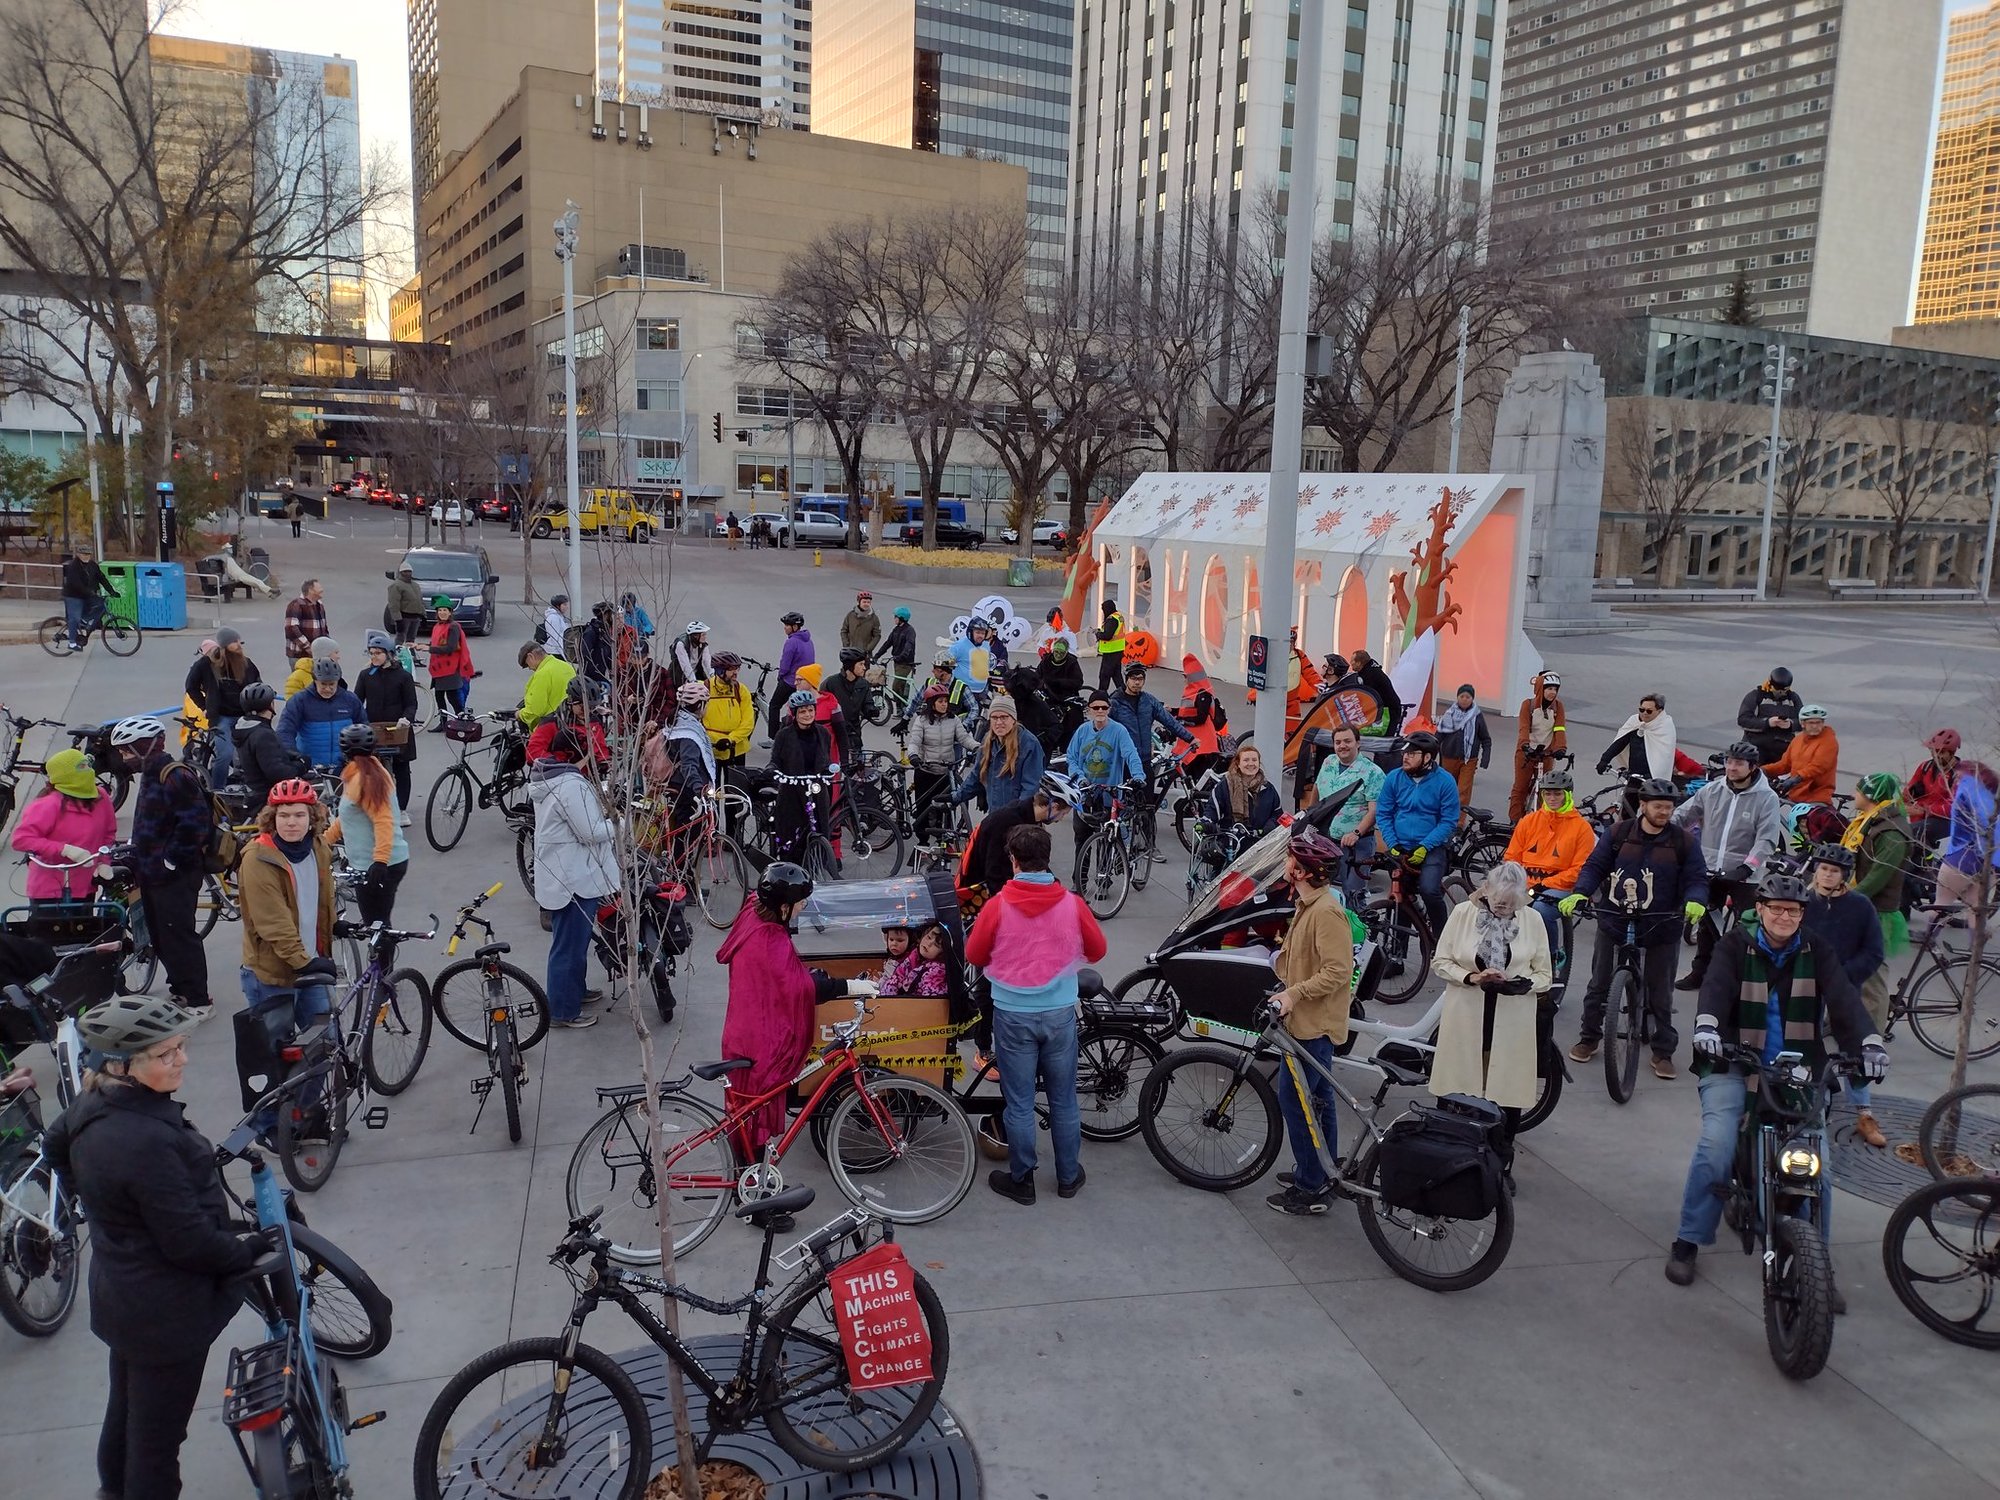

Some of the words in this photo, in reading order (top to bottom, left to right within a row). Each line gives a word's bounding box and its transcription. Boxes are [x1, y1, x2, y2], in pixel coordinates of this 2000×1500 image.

[1340, 694, 1363, 727] JANZ
[871, 1033, 908, 1045] DANGER
[921, 1027, 957, 1038] DANGER
[845, 1269, 898, 1296] THIS
[845, 1290, 912, 1318] MACHINE
[853, 1317, 908, 1338] FIGHTS
[854, 1332, 922, 1357] CLIMATE
[860, 1358, 923, 1379] CHANGE
